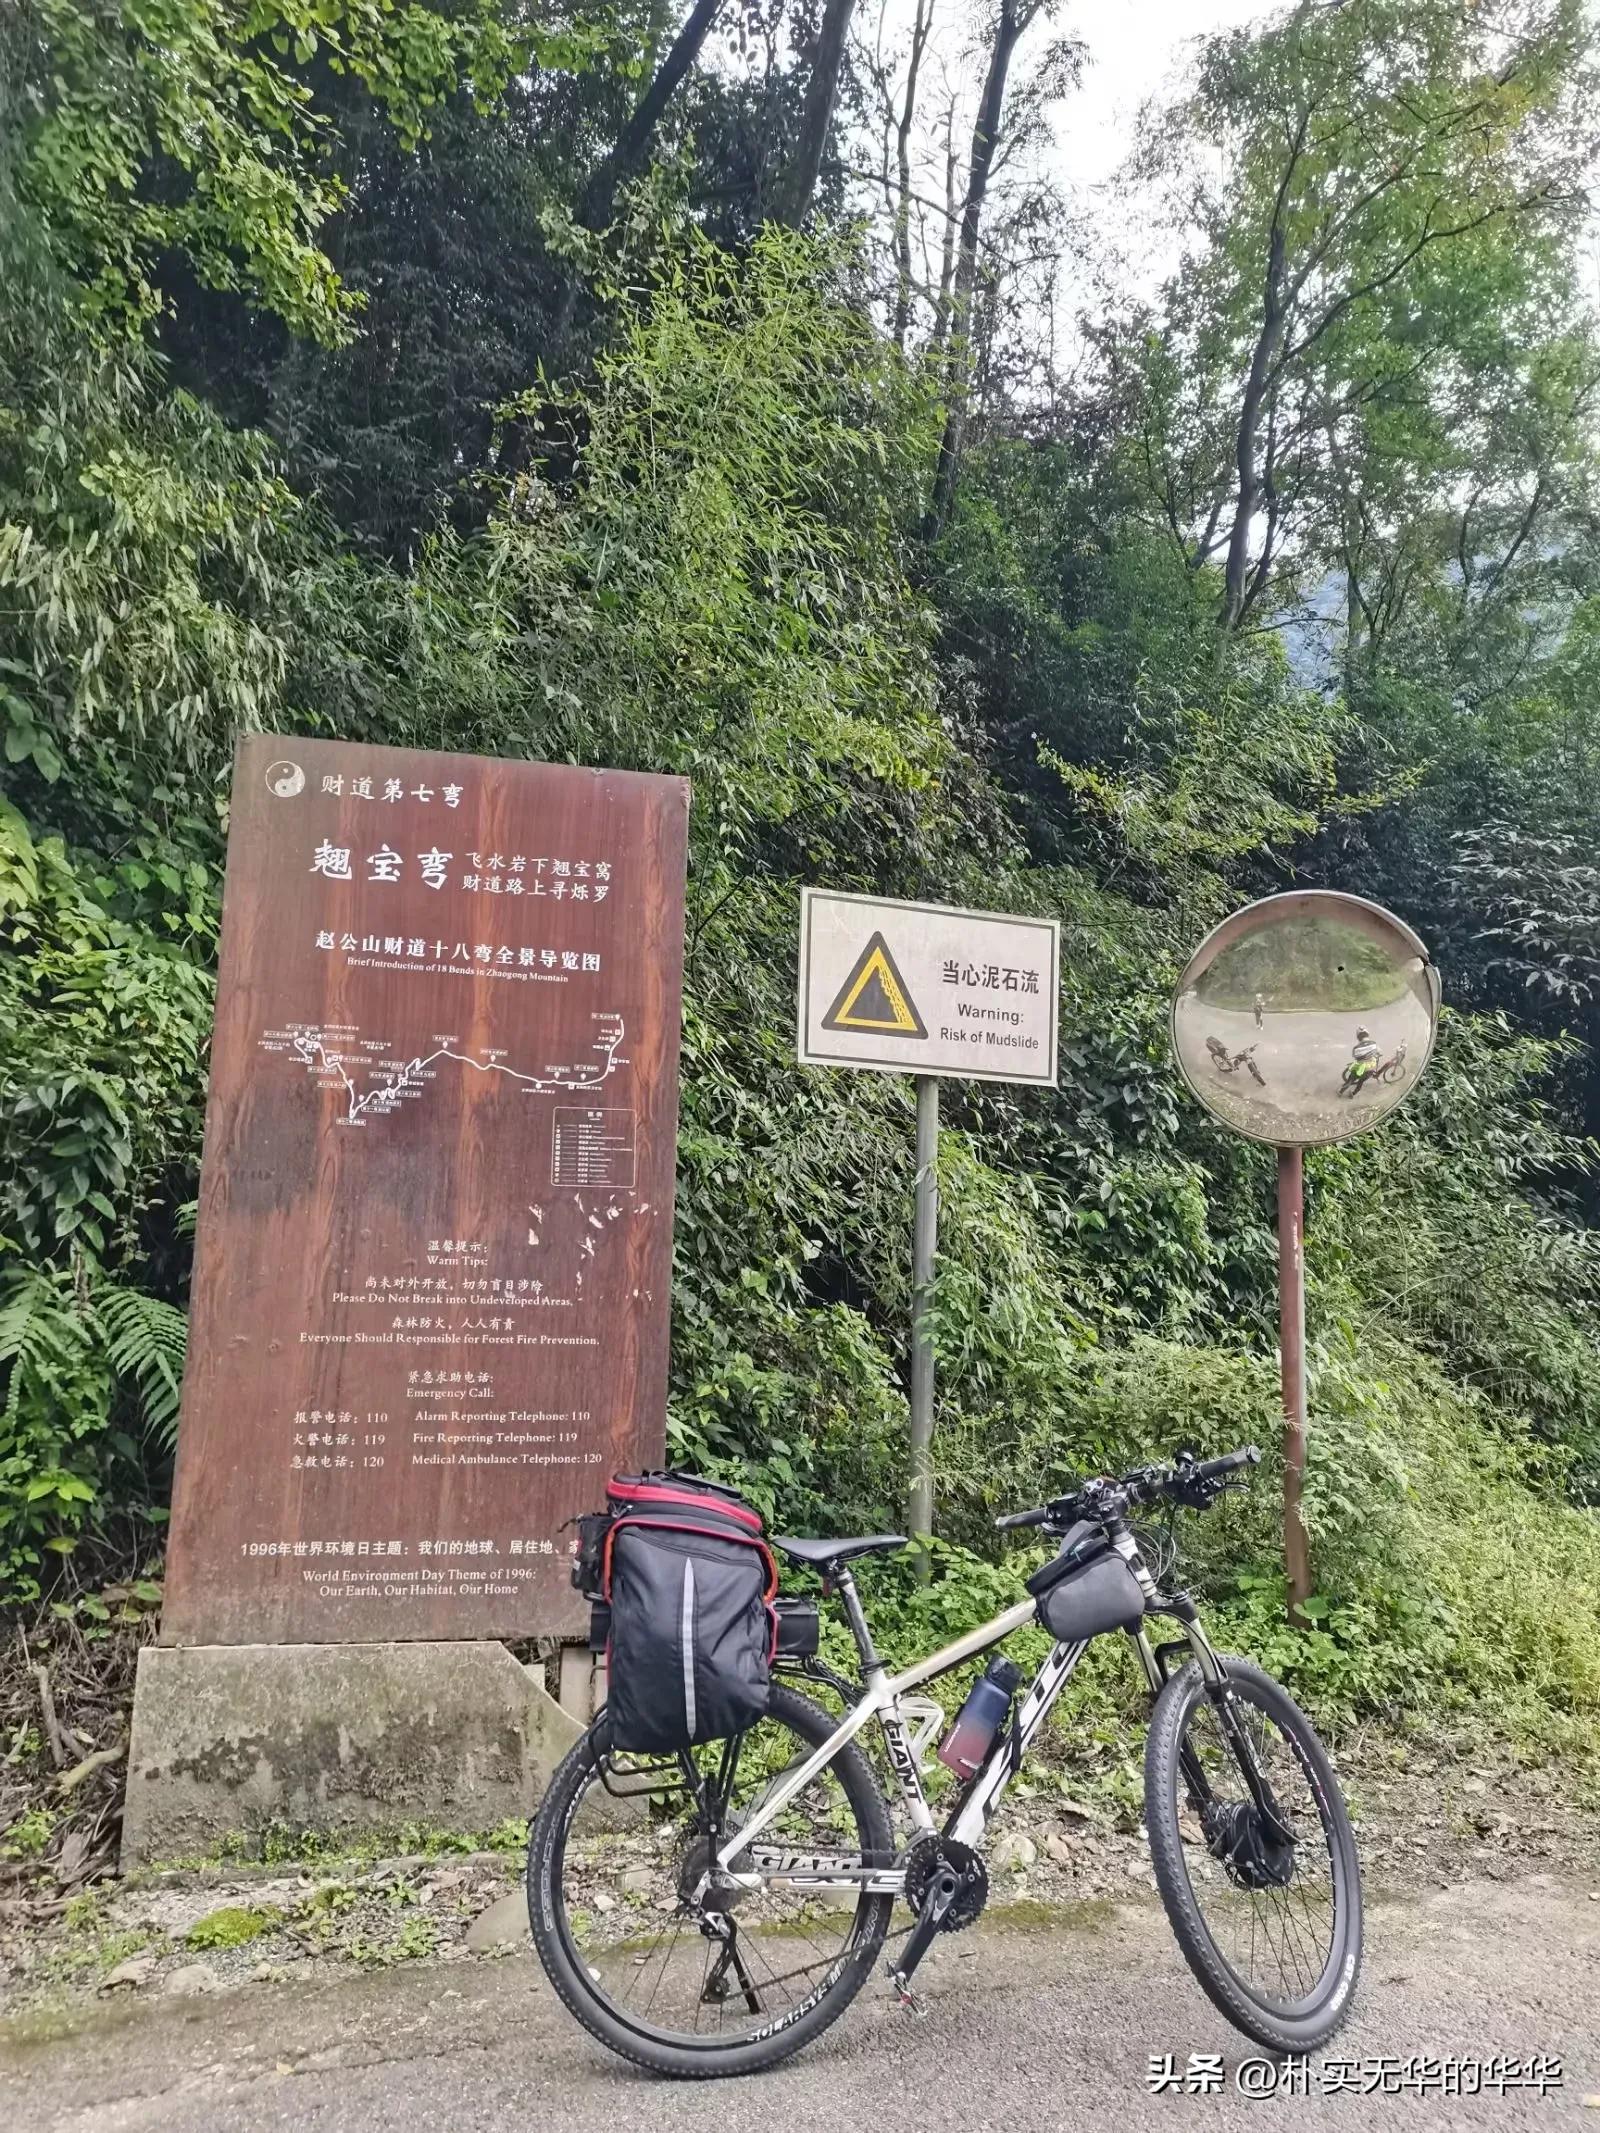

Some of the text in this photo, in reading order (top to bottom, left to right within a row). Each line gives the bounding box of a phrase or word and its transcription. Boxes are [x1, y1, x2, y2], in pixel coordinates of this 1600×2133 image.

[320, 774, 464, 808] 财道第七弯
[315, 930, 601, 972] 赵公山财道十八弯全景导览图
[346, 956, 569, 983] Brief Introduction of 18 Bends in Zhaogong Mountain
[942, 959, 1040, 994] 当心泥石流
[957, 1003, 1024, 1026] Warning:
[940, 1027, 1039, 1050] Risk of Mudslide
[426, 1255, 489, 1268] Warm Tips:
[332, 1292, 574, 1308] Please Do Not Break into Undeveloped Areas.
[299, 1332, 600, 1346] Everyone Should Responsible for Forest Fire Prevention.
[406, 1387, 494, 1401] Emergency Call:
[415, 1410, 591, 1424] Alarm Reporting Telephone: 110
[413, 1432, 578, 1445] Fire Reporting Telephone: 119
[412, 1453, 602, 1467] Medical Ambulance Telephone: 120
[302, 1568, 536, 1583] World Environment Day Theme of 1996:
[319, 1583, 518, 1597] Our Earth, Our Habitat, Our Home
[883, 1718, 924, 1803] GIANT
